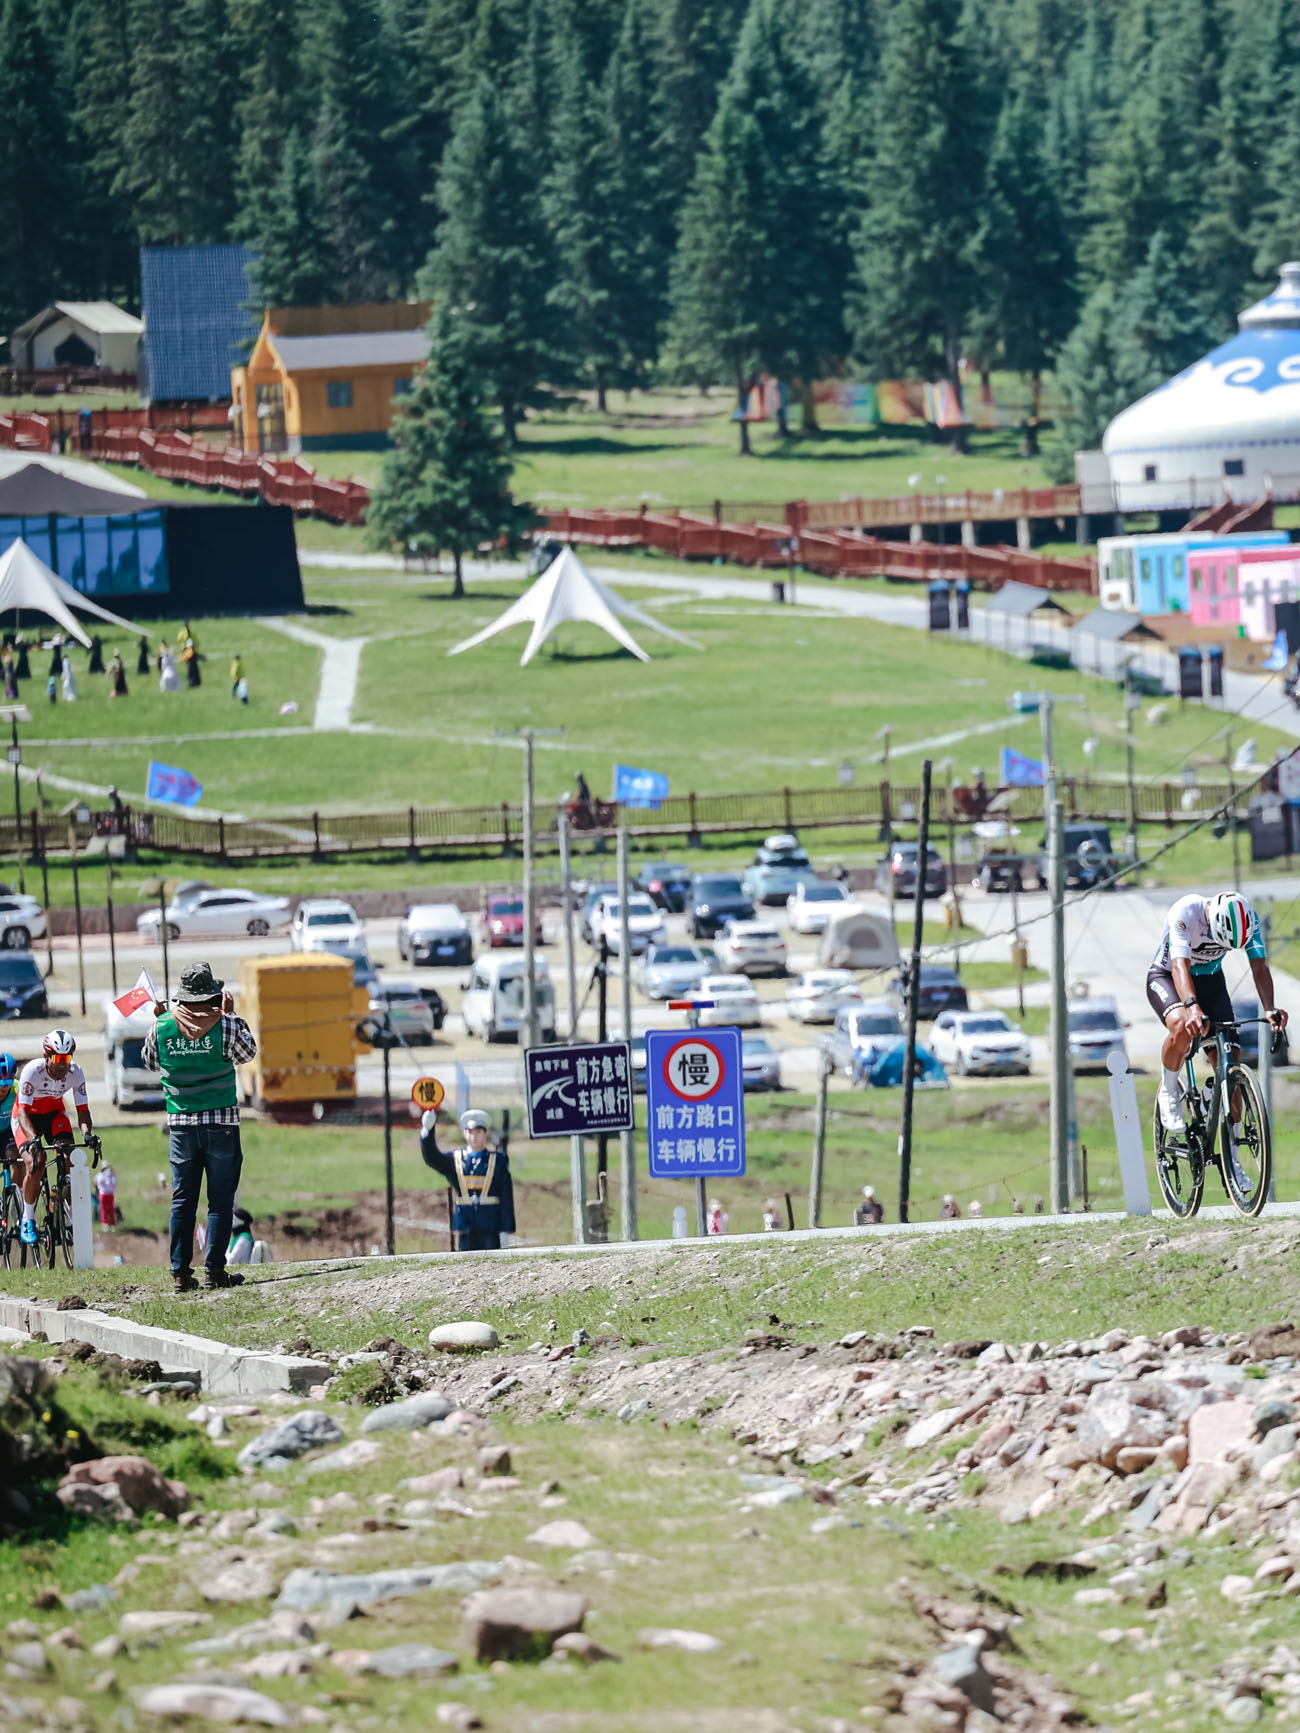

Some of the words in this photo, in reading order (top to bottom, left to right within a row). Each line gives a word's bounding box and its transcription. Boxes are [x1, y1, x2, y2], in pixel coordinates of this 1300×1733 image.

[576, 1053, 626, 1086] 前方急弯
[678, 1053, 710, 1087] 慢
[418, 1081, 437, 1103] 慢
[577, 1085, 629, 1118] 车辆慢行
[655, 1103, 735, 1130] 前方路口
[656, 1137, 737, 1165] 车辆慢行
